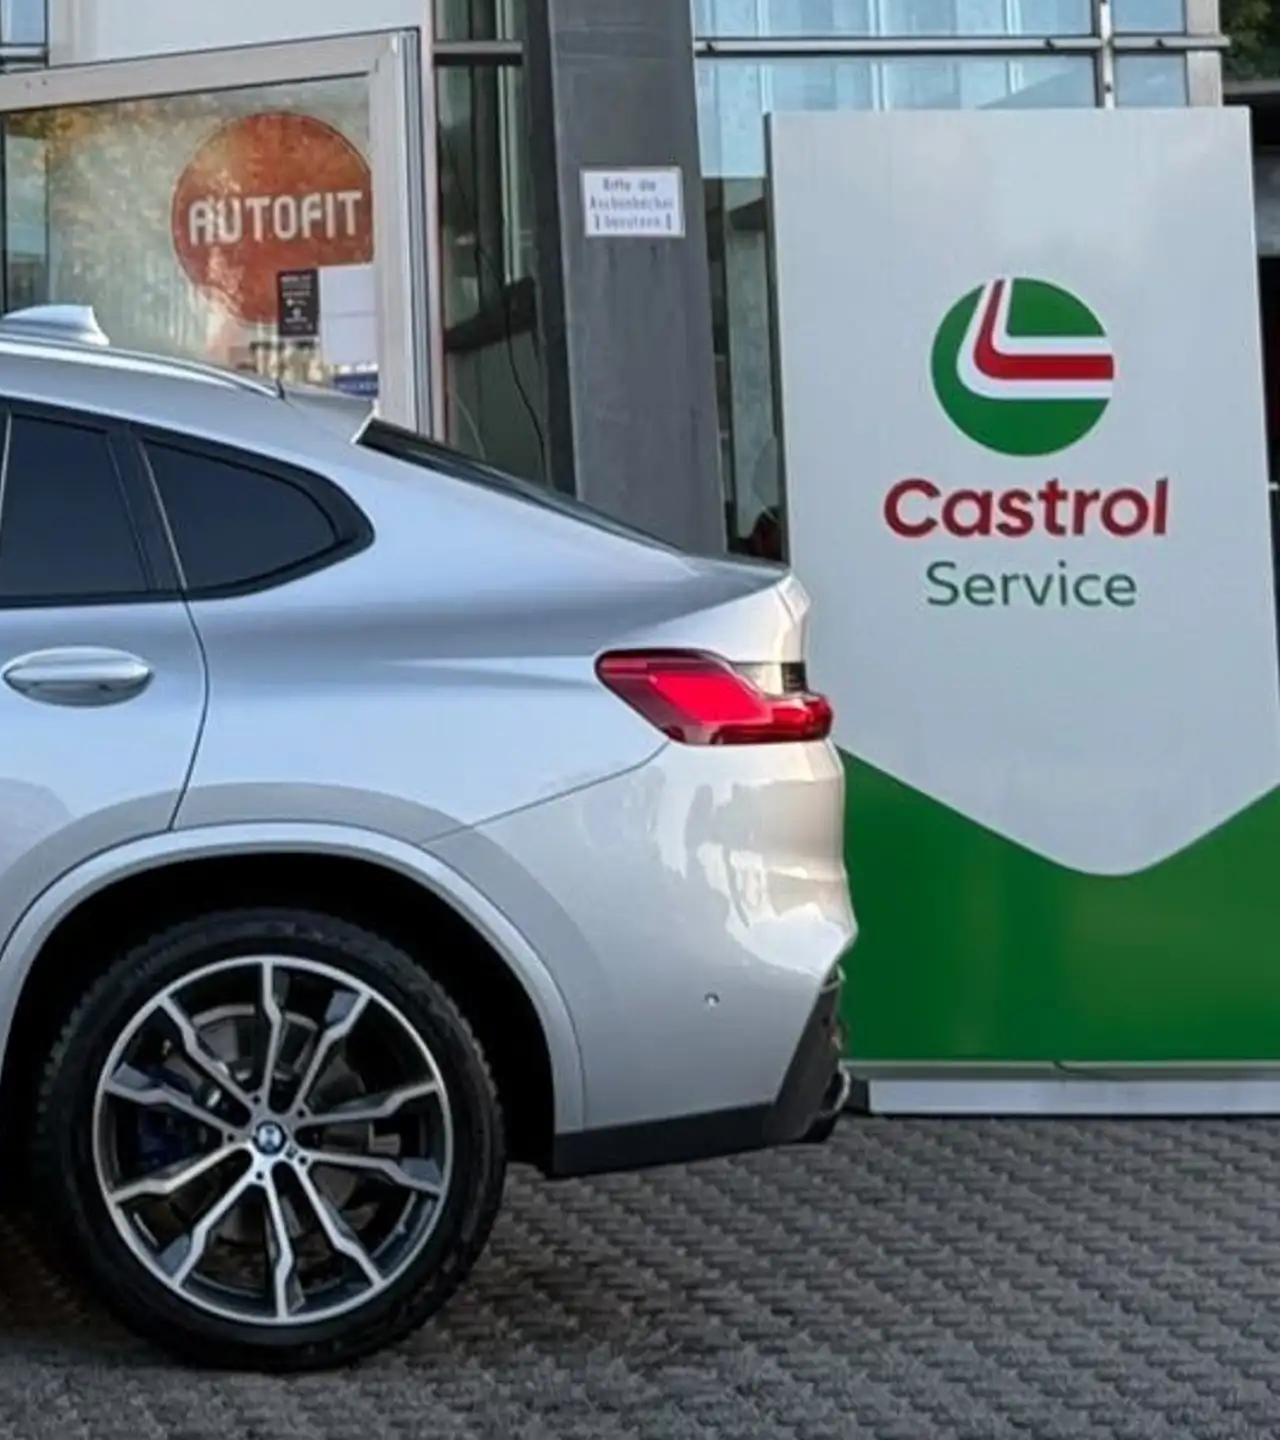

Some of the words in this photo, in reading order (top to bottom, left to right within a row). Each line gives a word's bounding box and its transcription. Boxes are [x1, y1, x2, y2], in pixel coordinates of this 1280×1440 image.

[189, 189, 363, 248] AUTOFIT
[883, 477, 1169, 538] Castrol
[926, 559, 1137, 607] Service
